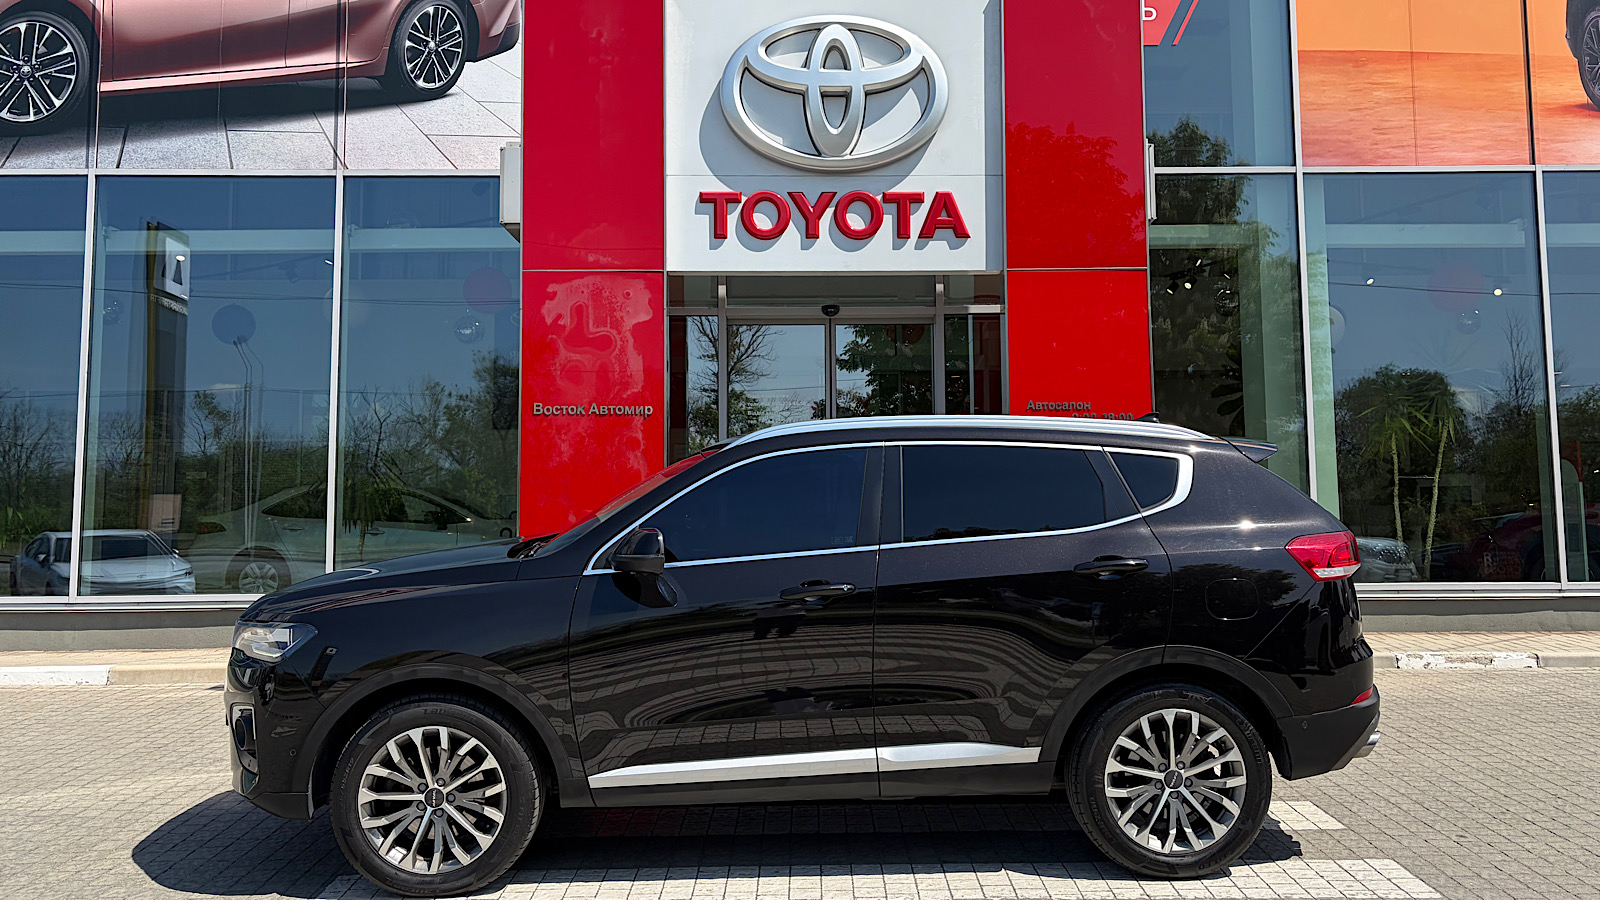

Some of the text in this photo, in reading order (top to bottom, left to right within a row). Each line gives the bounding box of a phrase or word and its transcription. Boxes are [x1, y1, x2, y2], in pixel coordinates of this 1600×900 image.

[699, 190, 971, 240] TOYOTA
[533, 402, 653, 419] Восток Автомир
[1026, 400, 1091, 411] Автосалон
